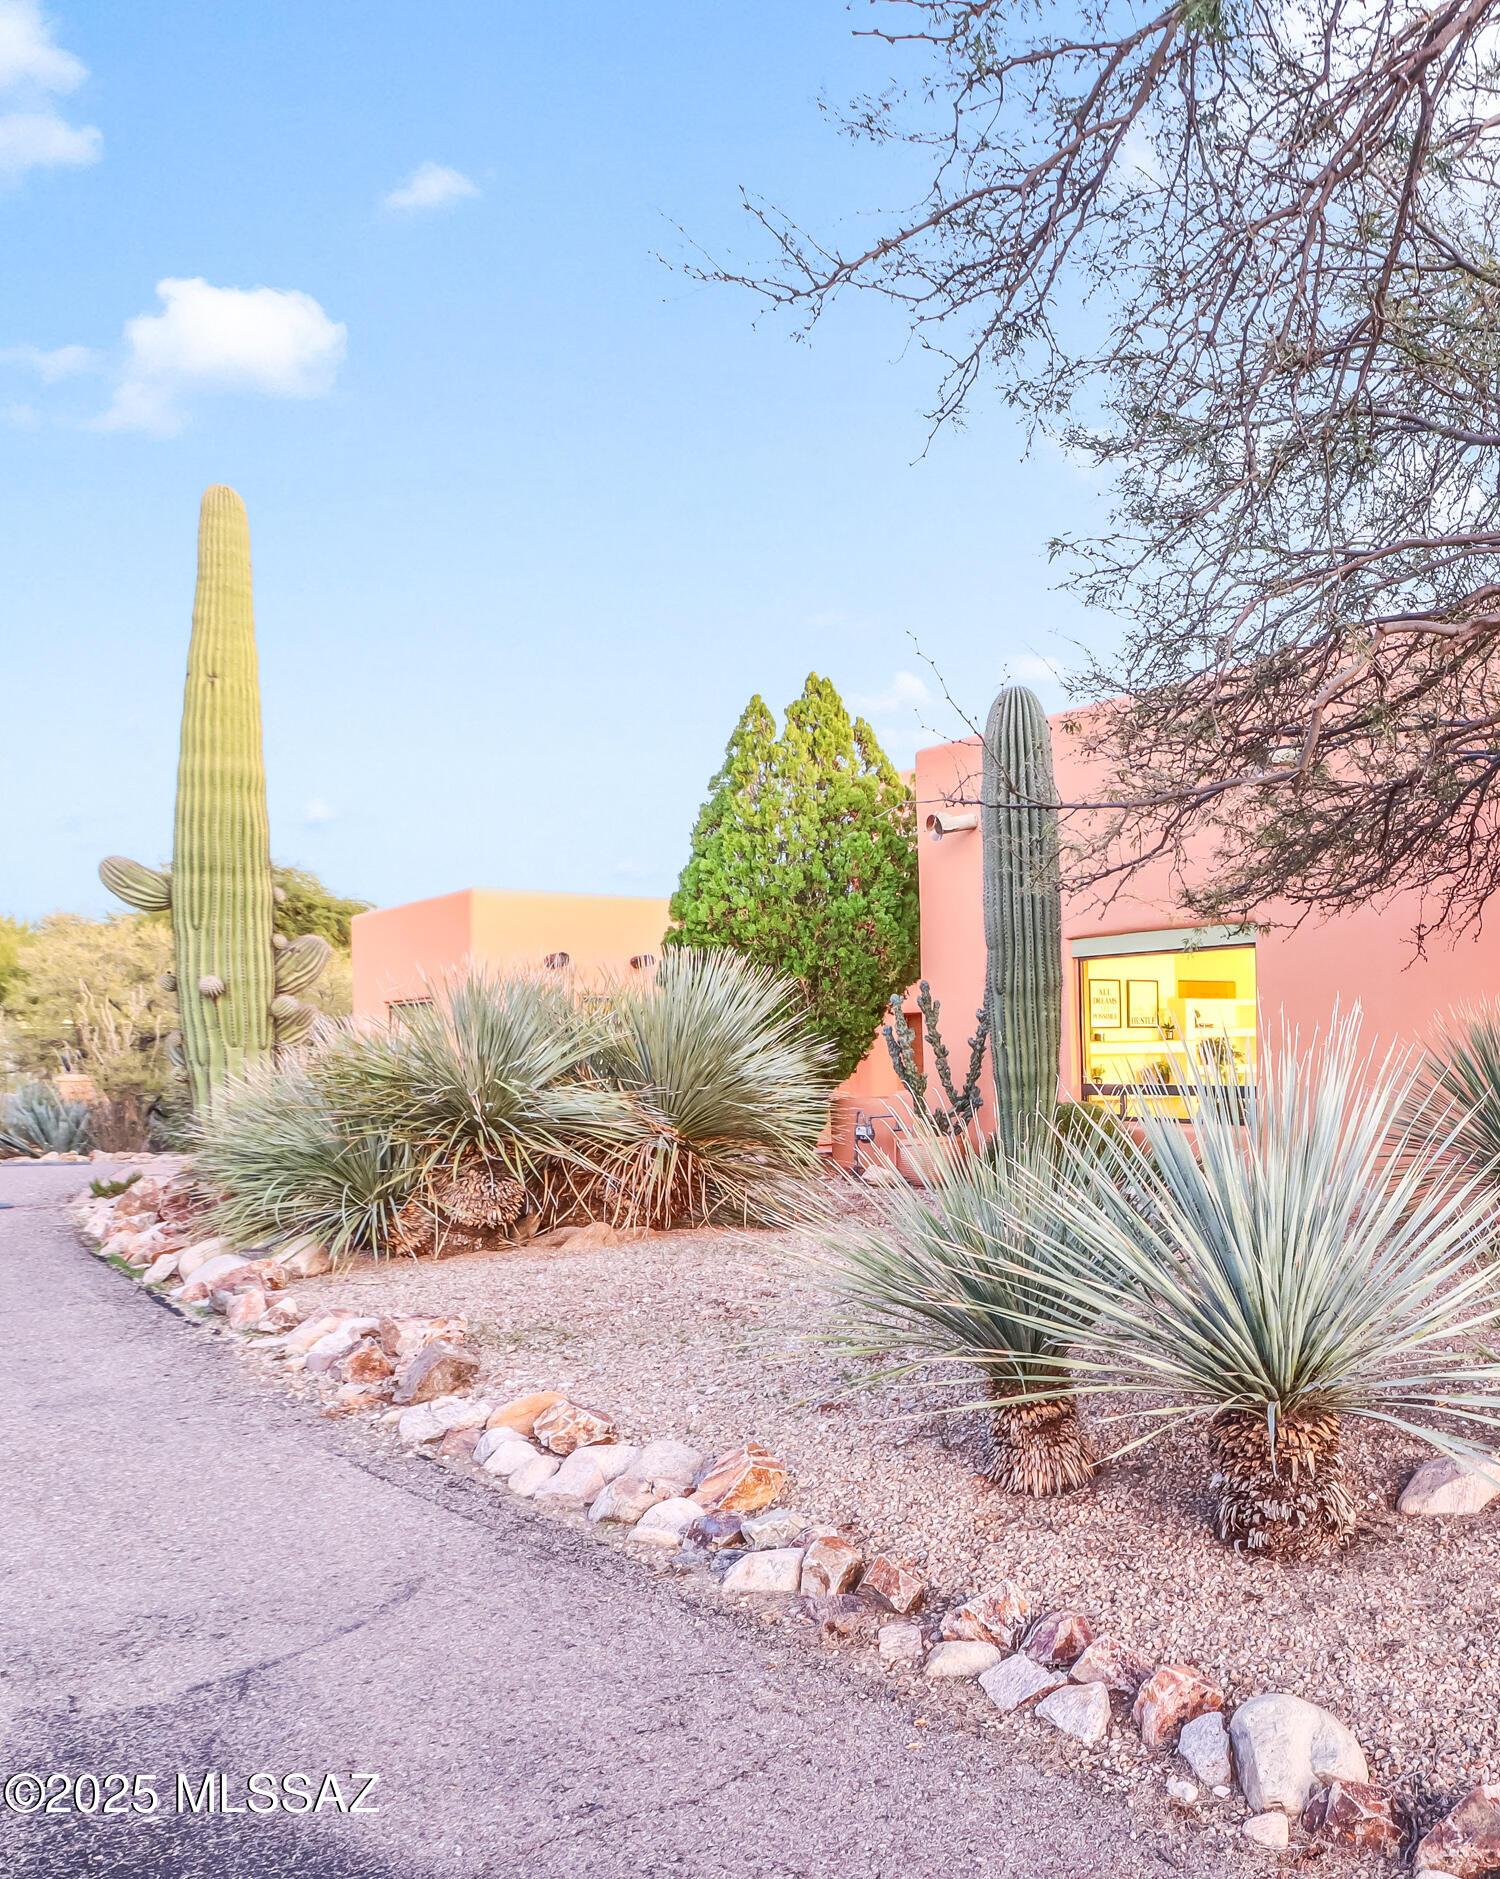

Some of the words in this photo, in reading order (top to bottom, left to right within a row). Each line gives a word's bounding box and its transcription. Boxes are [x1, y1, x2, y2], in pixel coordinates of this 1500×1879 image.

[1099, 988, 1111, 996] ALL
[1093, 997, 1117, 1005] DREAMS
[1131, 1016, 1156, 1025] HUSTLE
